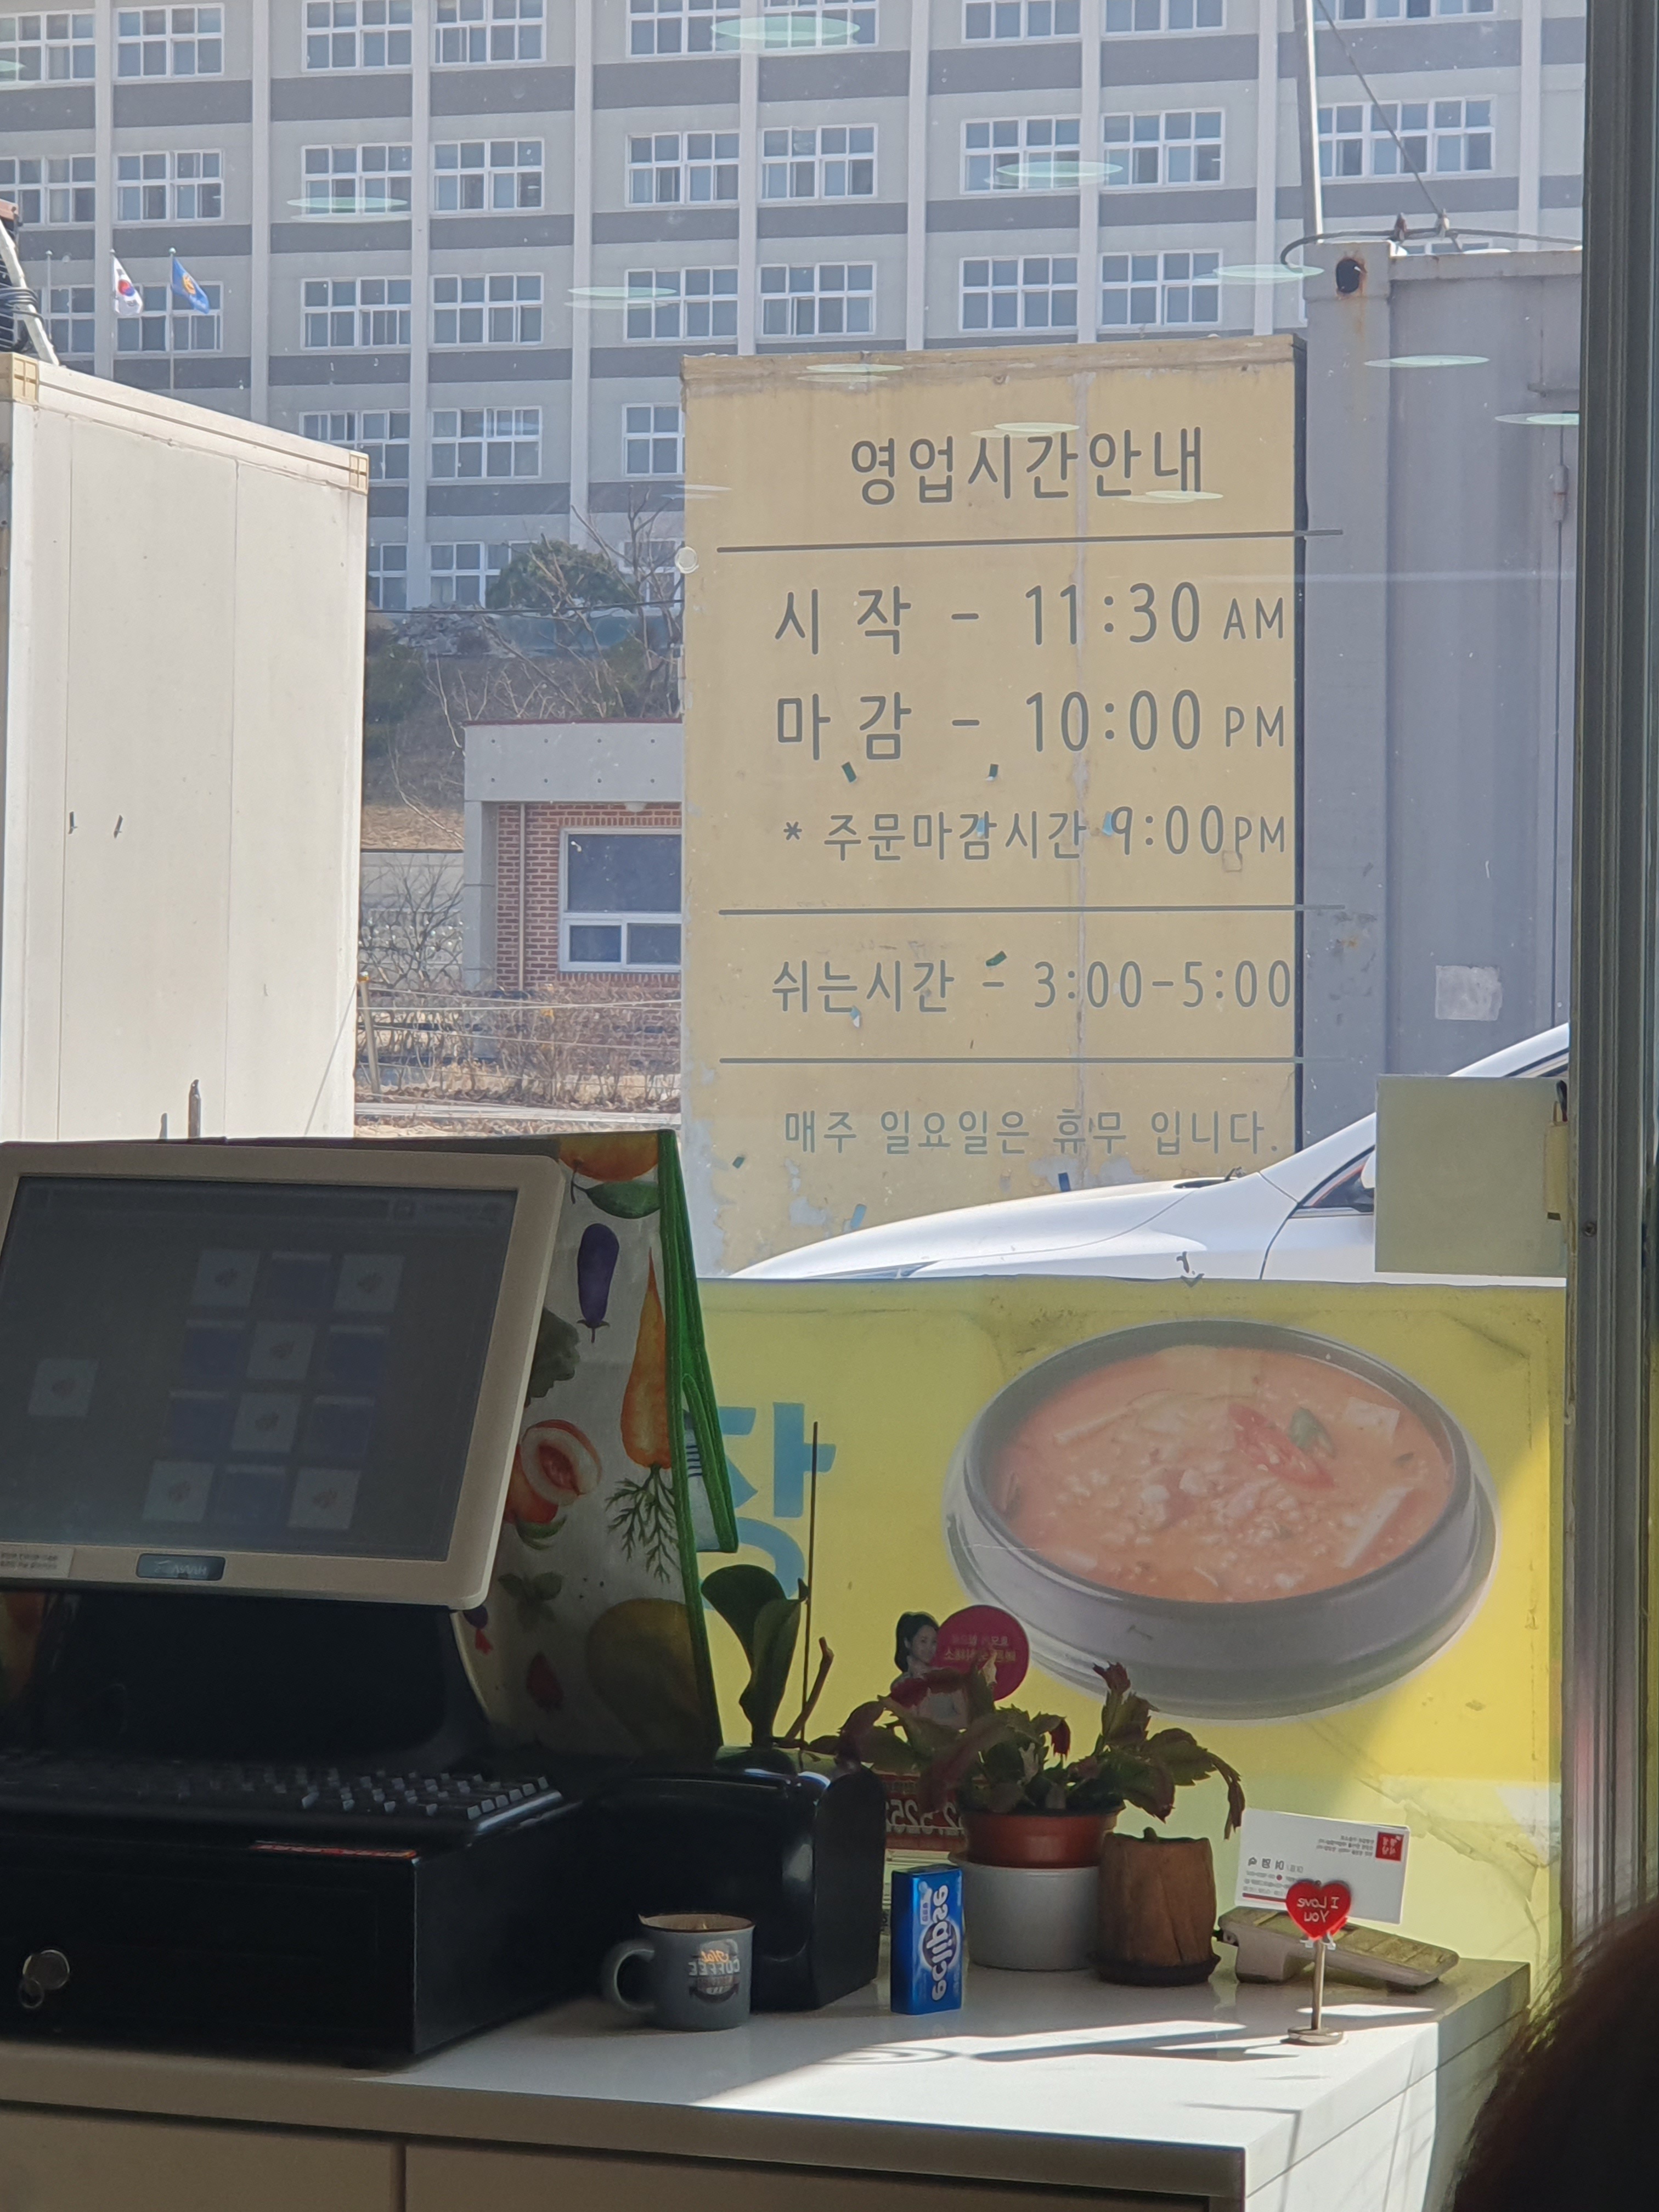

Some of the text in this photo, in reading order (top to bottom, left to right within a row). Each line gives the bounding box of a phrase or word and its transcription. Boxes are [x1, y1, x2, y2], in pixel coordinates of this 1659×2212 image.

[851, 426, 1201, 506] 영업시간안내
[1025, 581, 1200, 646] 11:30
[1223, 597, 1284, 640] AM
[1025, 689, 1201, 753] 10:00
[1225, 705, 1284, 748] PM
[771, 959, 955, 1013] 쉬는시간
[785, 1110, 857, 1154] 매주
[880, 1110, 1030, 1155] 일요일은
[1052, 1108, 1127, 1154] 휴무
